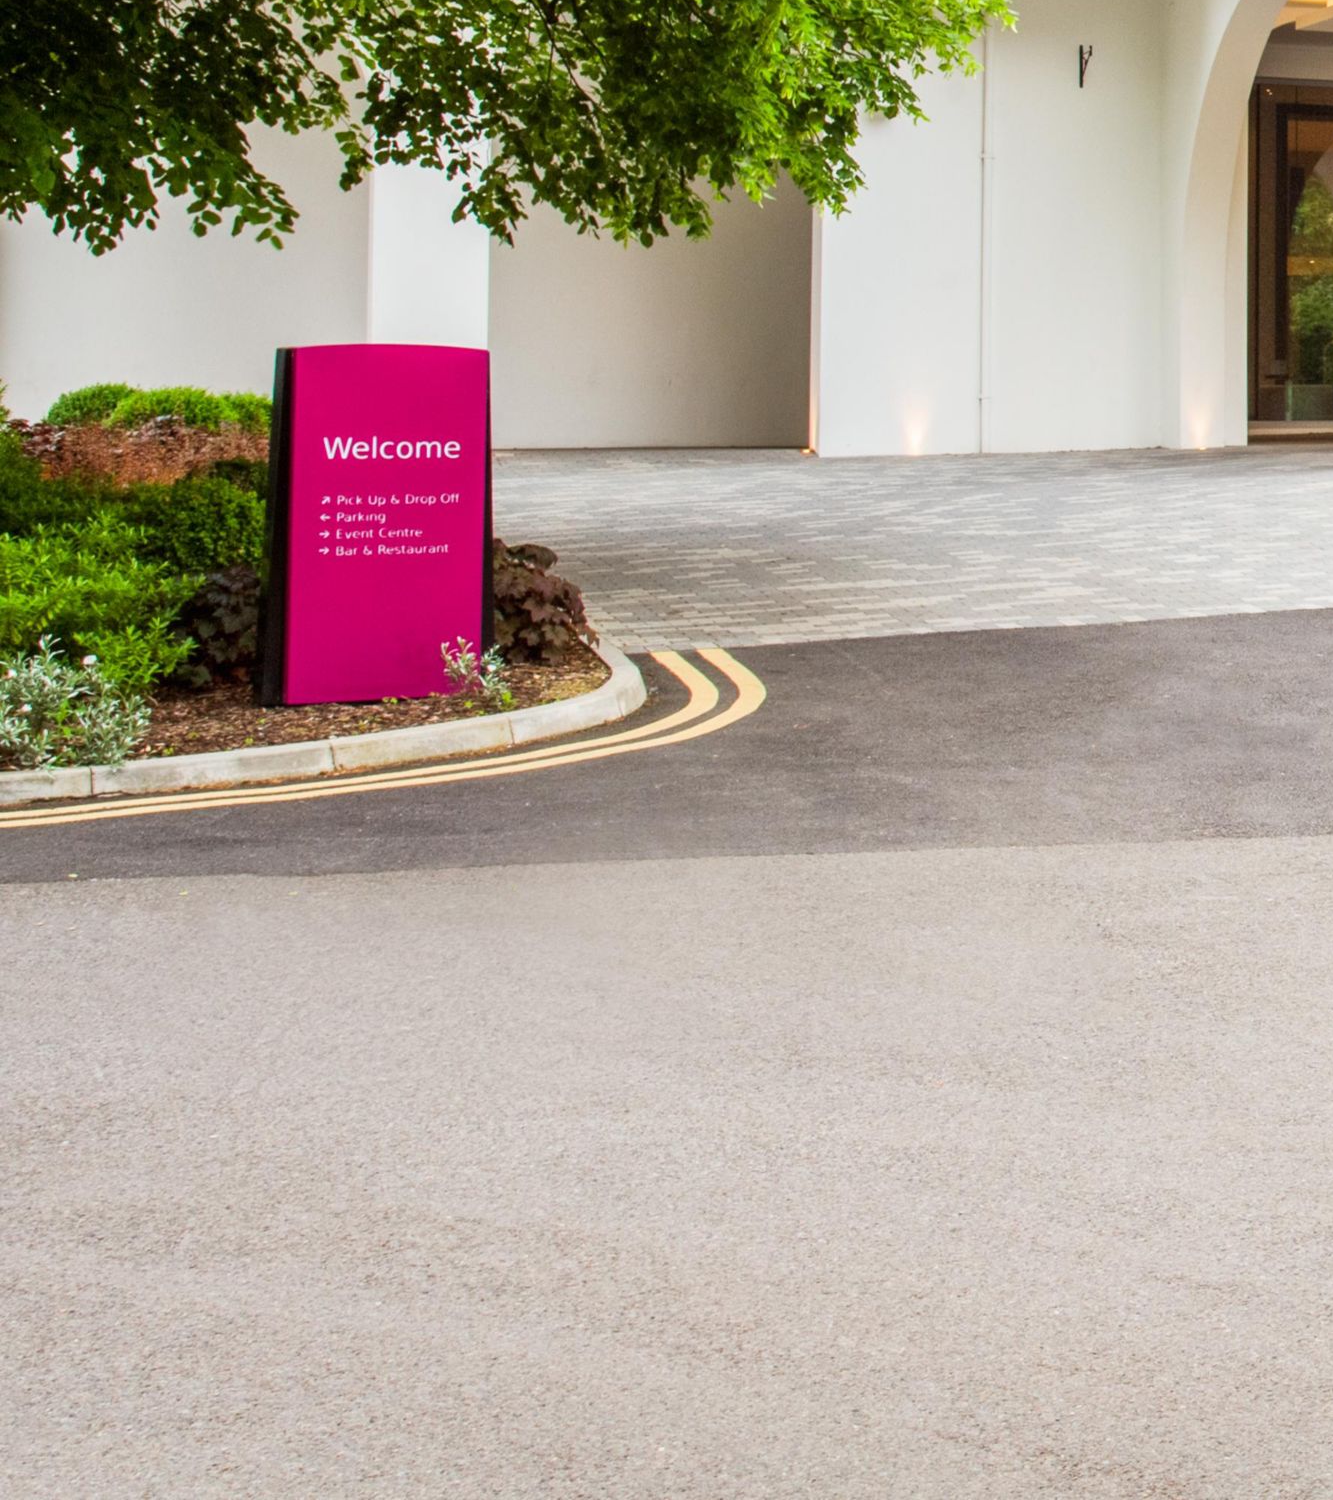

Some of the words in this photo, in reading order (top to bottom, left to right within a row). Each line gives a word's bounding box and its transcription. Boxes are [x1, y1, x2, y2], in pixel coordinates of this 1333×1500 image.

[323, 436, 461, 459] Welcome
[336, 495, 362, 505] Pick
[368, 495, 386, 507] Up
[390, 494, 400, 504] &
[405, 493, 436, 506] Drop
[440, 493, 460, 504] Off
[336, 512, 386, 524] Parking
[336, 528, 373, 539] Event
[379, 527, 423, 538] Centre
[336, 545, 357, 556] Bar
[363, 545, 373, 556] &
[378, 544, 449, 555] Restaurant
